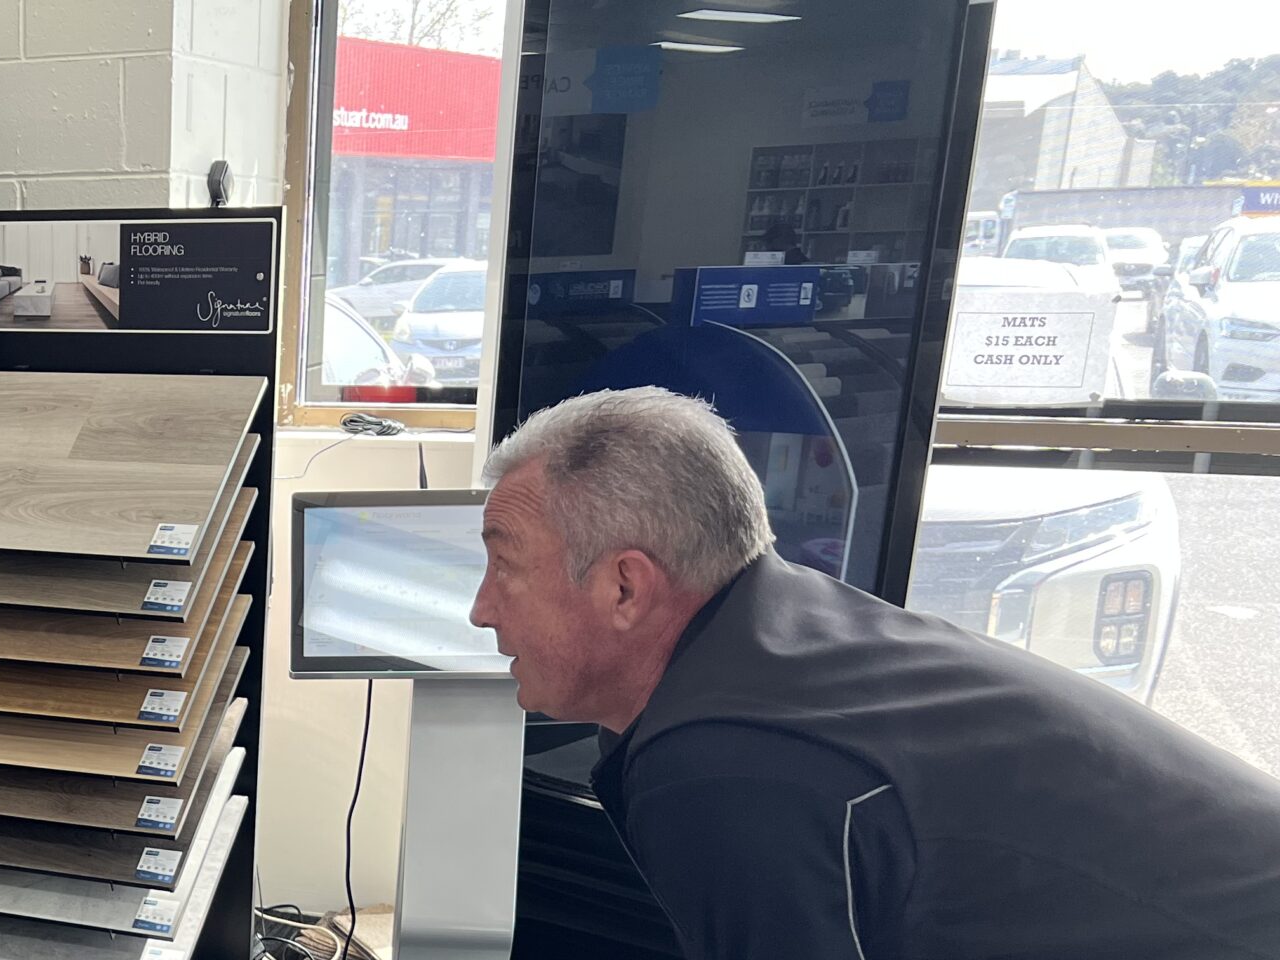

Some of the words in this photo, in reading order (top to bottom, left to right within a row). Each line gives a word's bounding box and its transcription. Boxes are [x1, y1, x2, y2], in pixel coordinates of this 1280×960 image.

[131, 232, 169, 243] HYBRID
[131, 245, 184, 256] FLOORING
[1001, 317, 1047, 328] MATS
[985, 335, 1010, 347] $15
[1013, 335, 1058, 346] EACH
[973, 354, 1015, 365] CASH
[1018, 354, 1064, 366] ONLY
